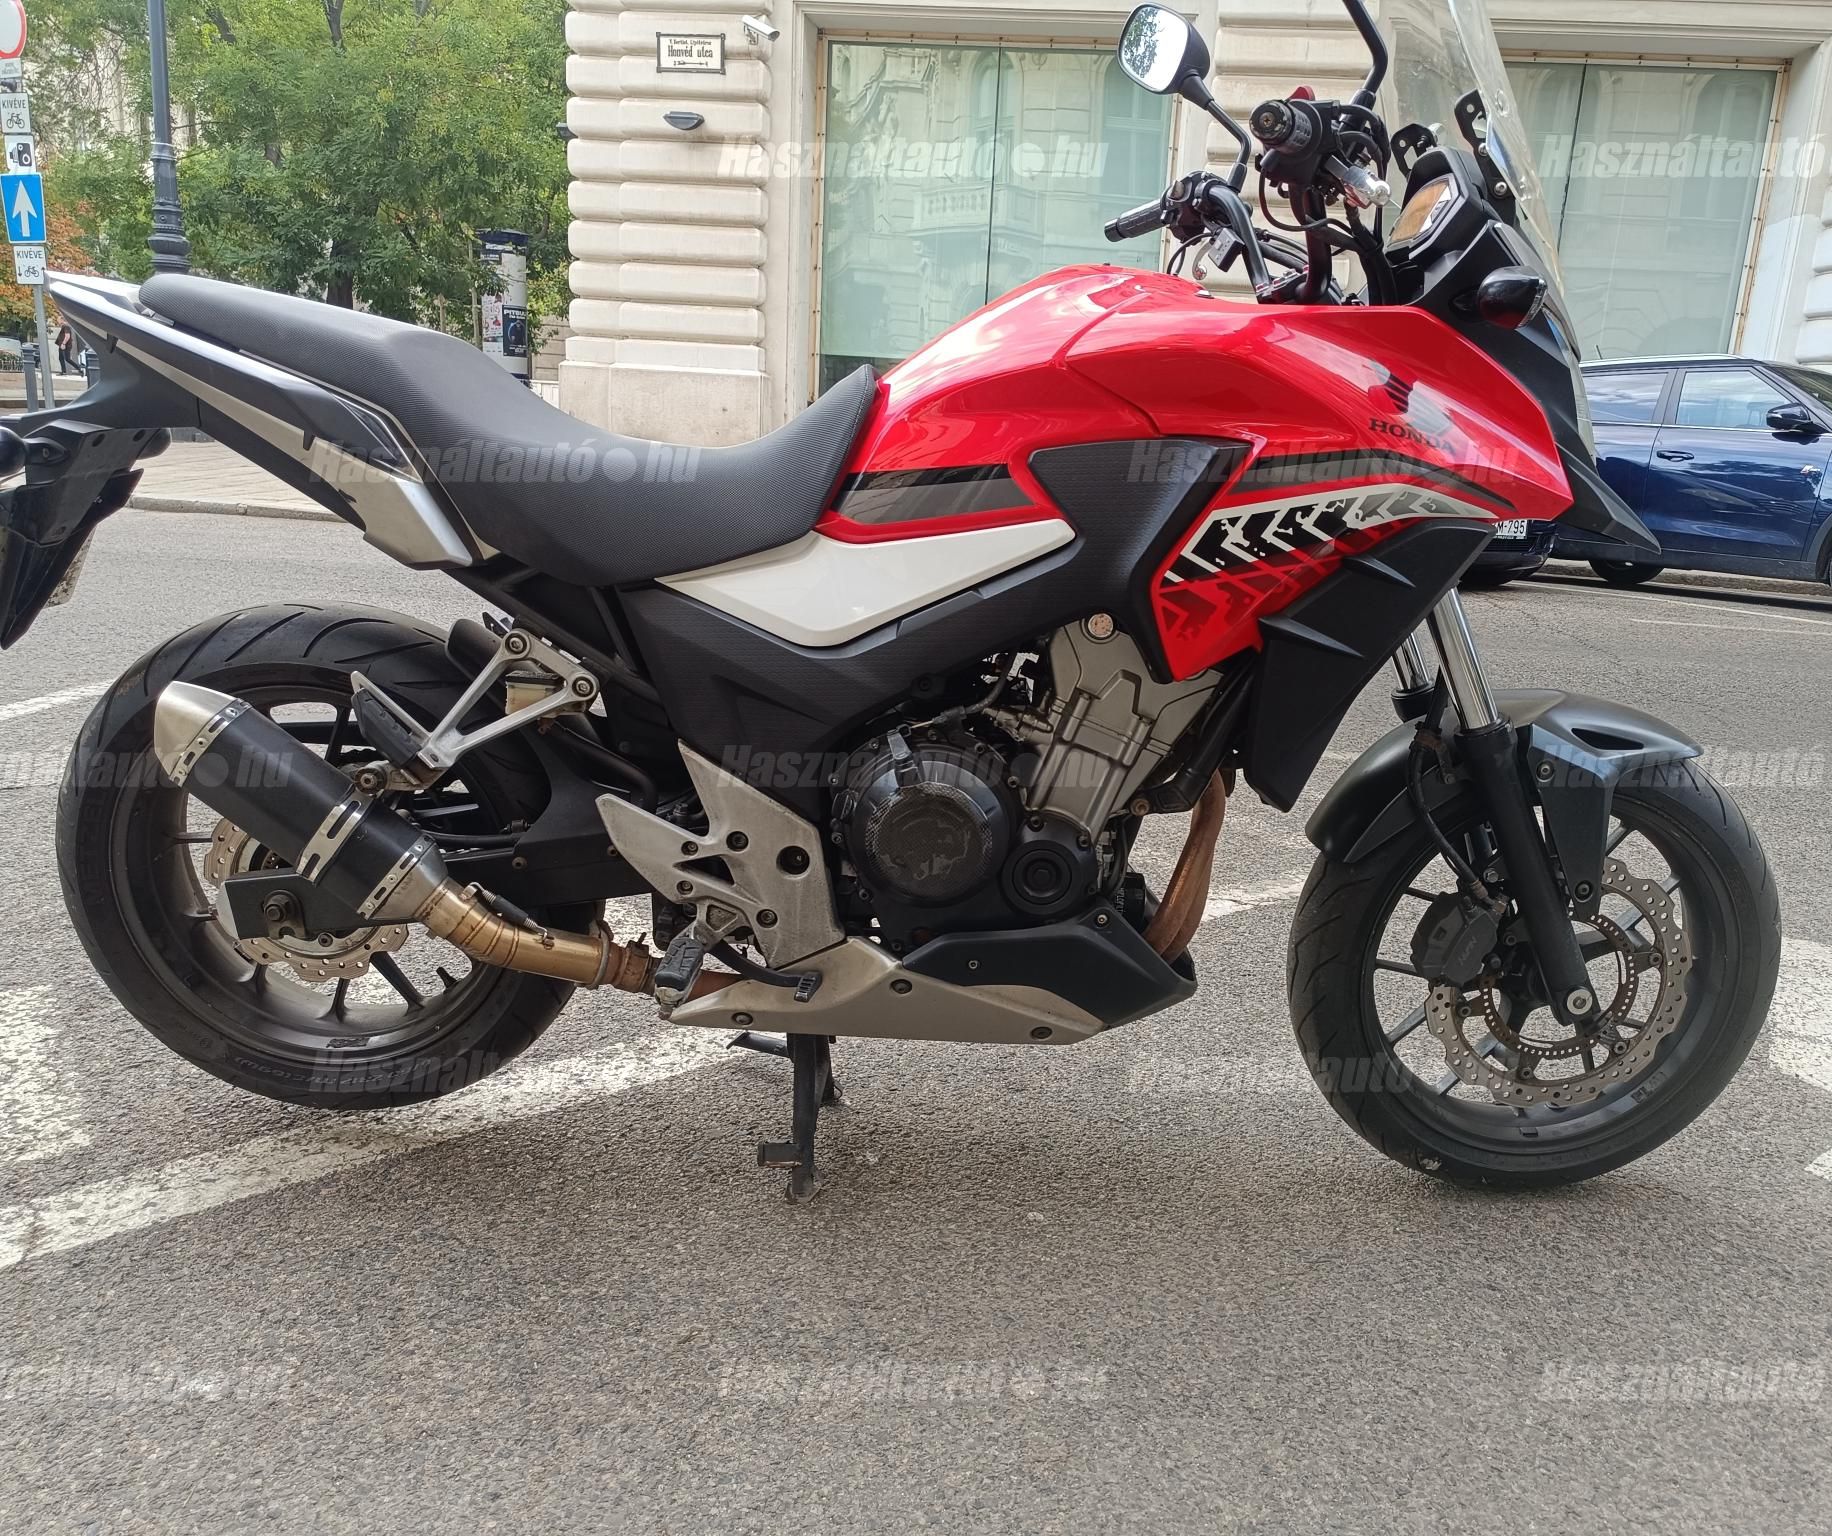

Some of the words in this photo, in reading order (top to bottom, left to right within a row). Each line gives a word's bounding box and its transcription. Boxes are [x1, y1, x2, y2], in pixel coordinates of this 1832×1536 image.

[667, 45, 693, 58] Honvéd
[696, 46, 713, 58] utca
[1, 97, 27, 109] KIVÉVE
[16, 247, 44, 259] KIVÉVE
[1368, 417, 1457, 457] HONDA
